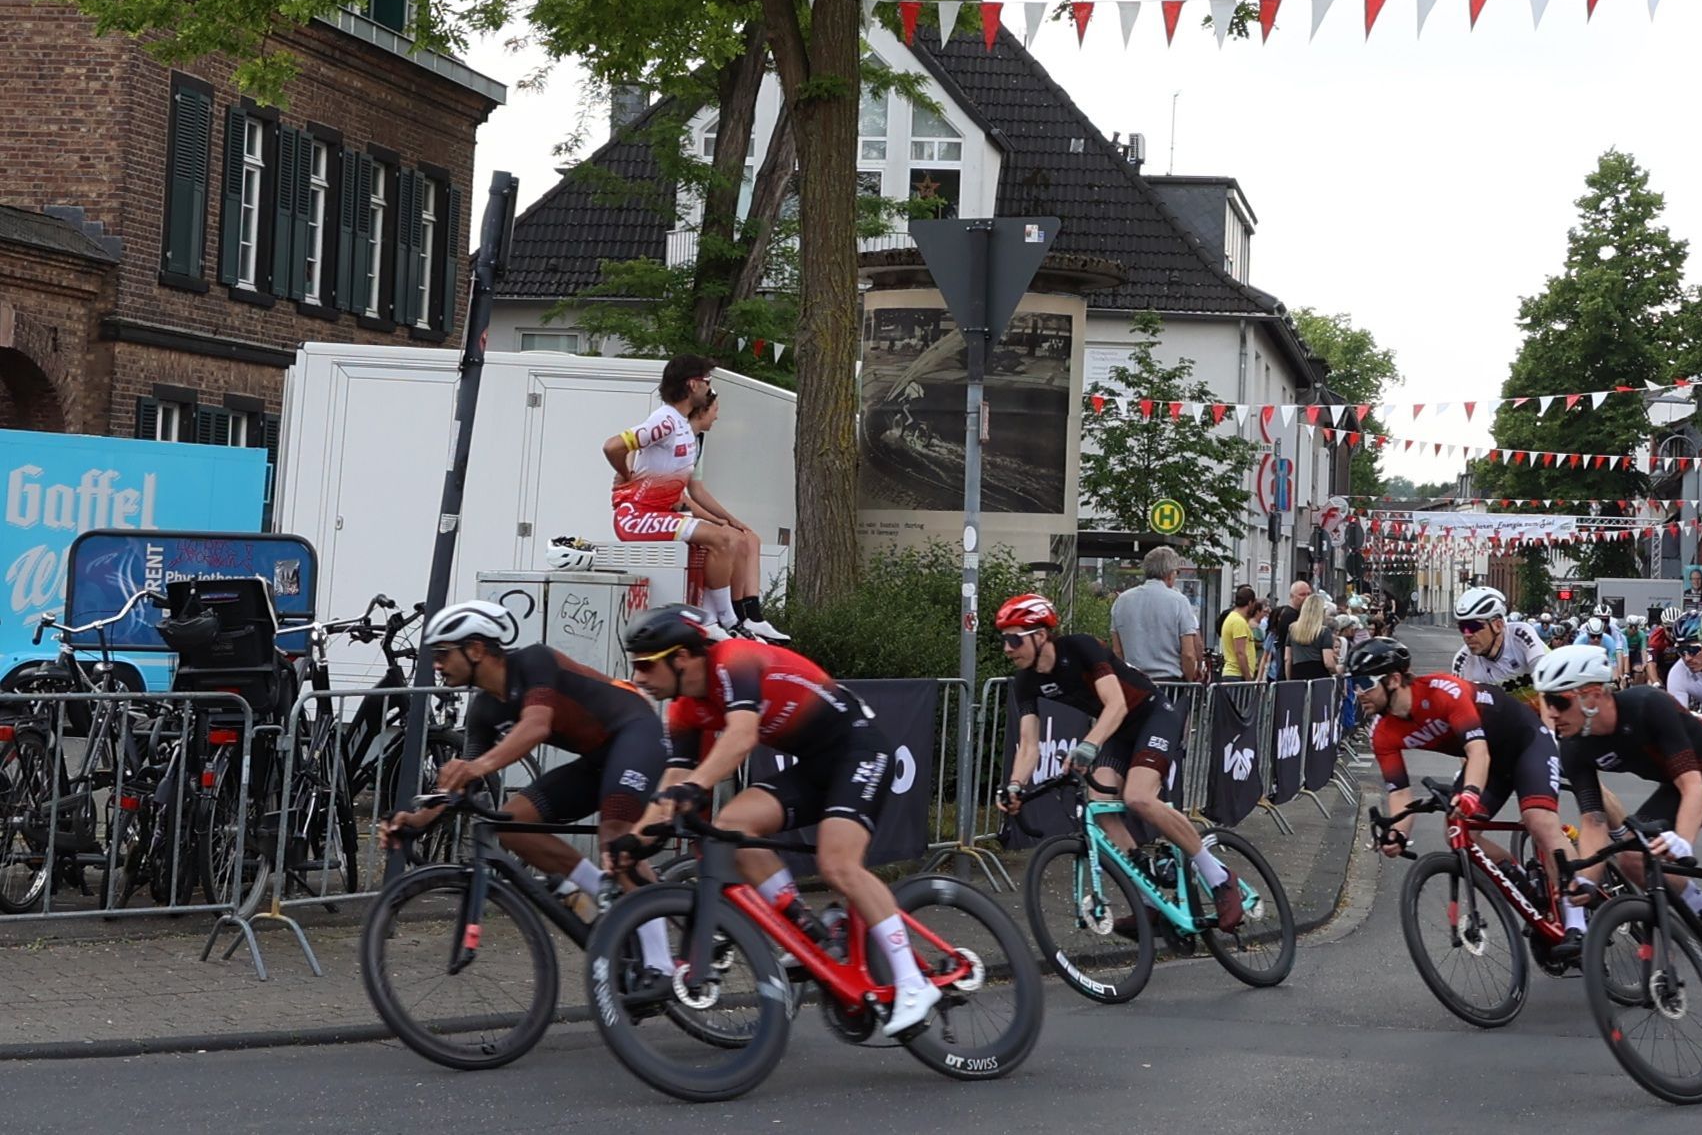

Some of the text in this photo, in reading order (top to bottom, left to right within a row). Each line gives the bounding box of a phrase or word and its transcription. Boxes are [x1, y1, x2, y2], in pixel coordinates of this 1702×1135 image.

[5, 463, 160, 532] Gaffel
[1158, 507, 1176, 526] H
[1470, 843, 1544, 922] THOMPSON
[944, 1053, 999, 1072] DT SWISS
